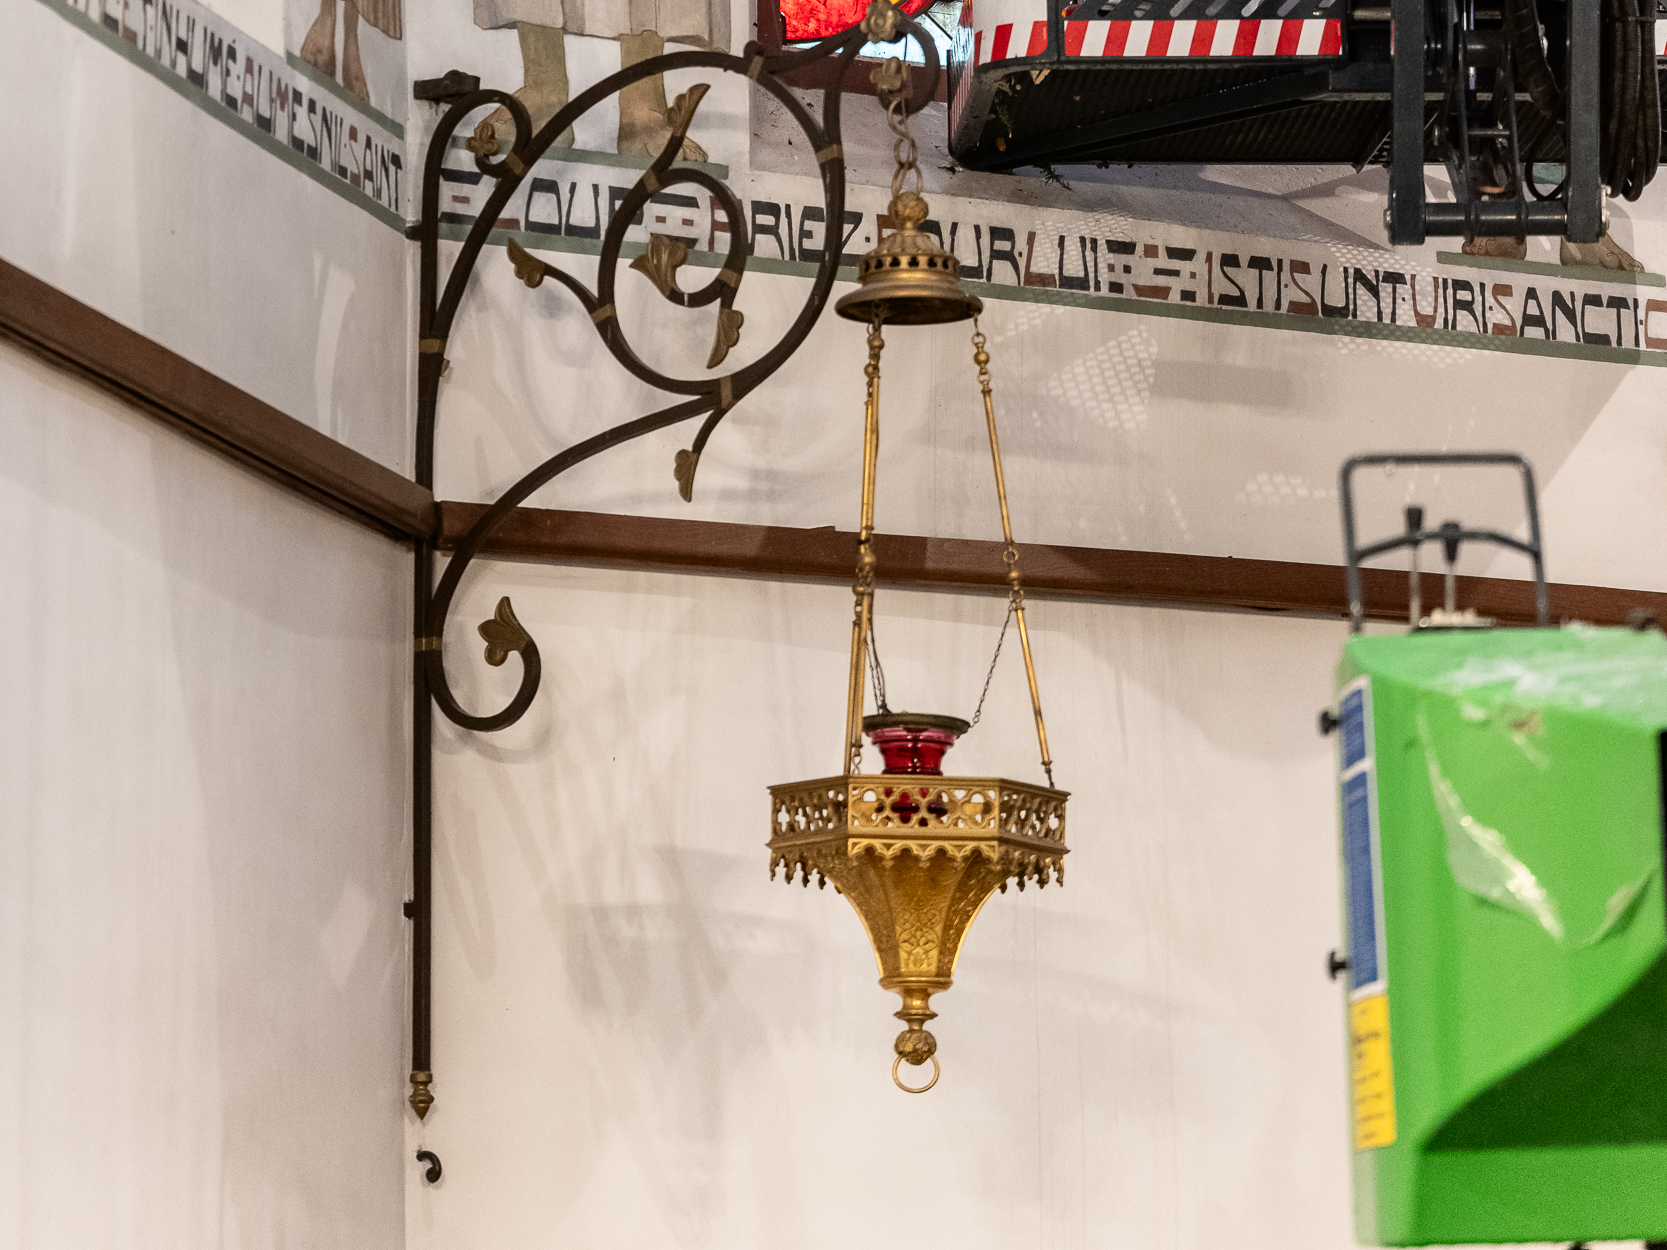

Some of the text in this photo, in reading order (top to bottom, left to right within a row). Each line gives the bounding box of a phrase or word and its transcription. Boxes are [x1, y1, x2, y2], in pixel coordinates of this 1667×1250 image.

[349, 123, 403, 213] SAINT
[1023, 231, 1102, 293] LUI
[1205, 250, 1284, 312] ISTI
[1286, 259, 1408, 324] SUNT
[1491, 282, 1640, 348] SANCTI
